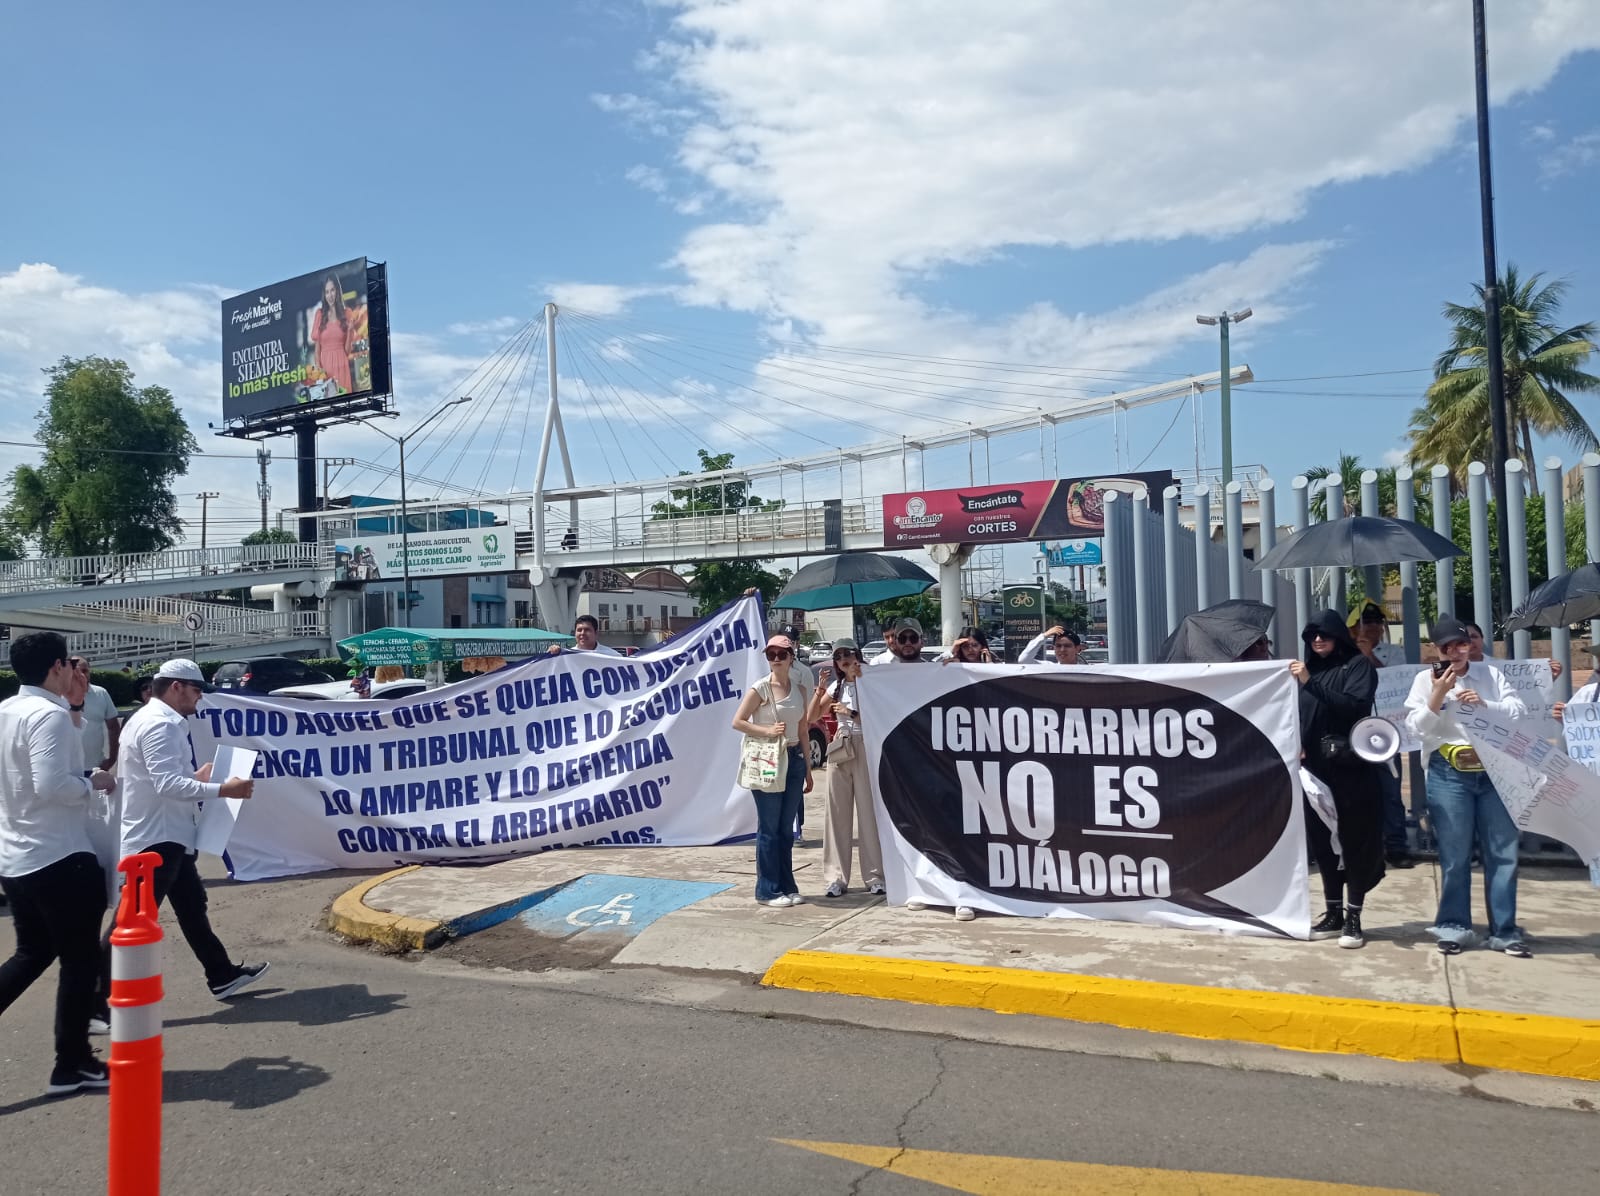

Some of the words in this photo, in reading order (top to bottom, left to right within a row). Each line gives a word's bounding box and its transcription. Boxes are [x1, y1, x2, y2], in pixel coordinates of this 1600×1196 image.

[232, 339, 283, 366] ENCUENTRA
[238, 352, 290, 383] SIEMPRE
[229, 382, 240, 398] lo
[242, 377, 269, 395] mas
[270, 364, 307, 388] fresh
[968, 495, 1018, 510] Encántate
[395, 541, 404, 549] LA
[422, 539, 433, 547] DEL
[433, 537, 472, 546] AGRICULTOR,
[967, 521, 1017, 534] CORTES
[386, 558, 402, 569] MÁS
[431, 557, 445, 565] DEL
[445, 555, 472, 564] CAMPO
[423, 547, 448, 556] SOMOS
[448, 546, 463, 554] LOS
[295, 710, 388, 737] AQUEL
[392, 700, 451, 728] QUE
[455, 690, 490, 719] SE
[496, 672, 579, 715] QUEJA
[582, 664, 640, 699] CON
[643, 619, 758, 687] JUSTICIA,
[252, 748, 323, 779] ENGA
[330, 744, 372, 776] UN
[379, 725, 520, 772] TRIBUNAL
[526, 715, 578, 754] QUE
[584, 710, 613, 743] LO
[618, 668, 742, 732] ESCUCHE,
[931, 706, 1217, 760] IGNORARNOS
[320, 789, 353, 816] LO
[359, 774, 480, 817] AMPARE
[485, 771, 502, 802] Y
[509, 766, 539, 799] LO
[547, 732, 674, 791] DEFIENDA
[337, 823, 453, 853] CONTRA
[455, 819, 486, 848] EL
[491, 775, 671, 844] ARBITRARIO”
[955, 760, 1056, 841] NO
[1093, 765, 1161, 829] ES
[987, 840, 1172, 898] DIÁLOGO
